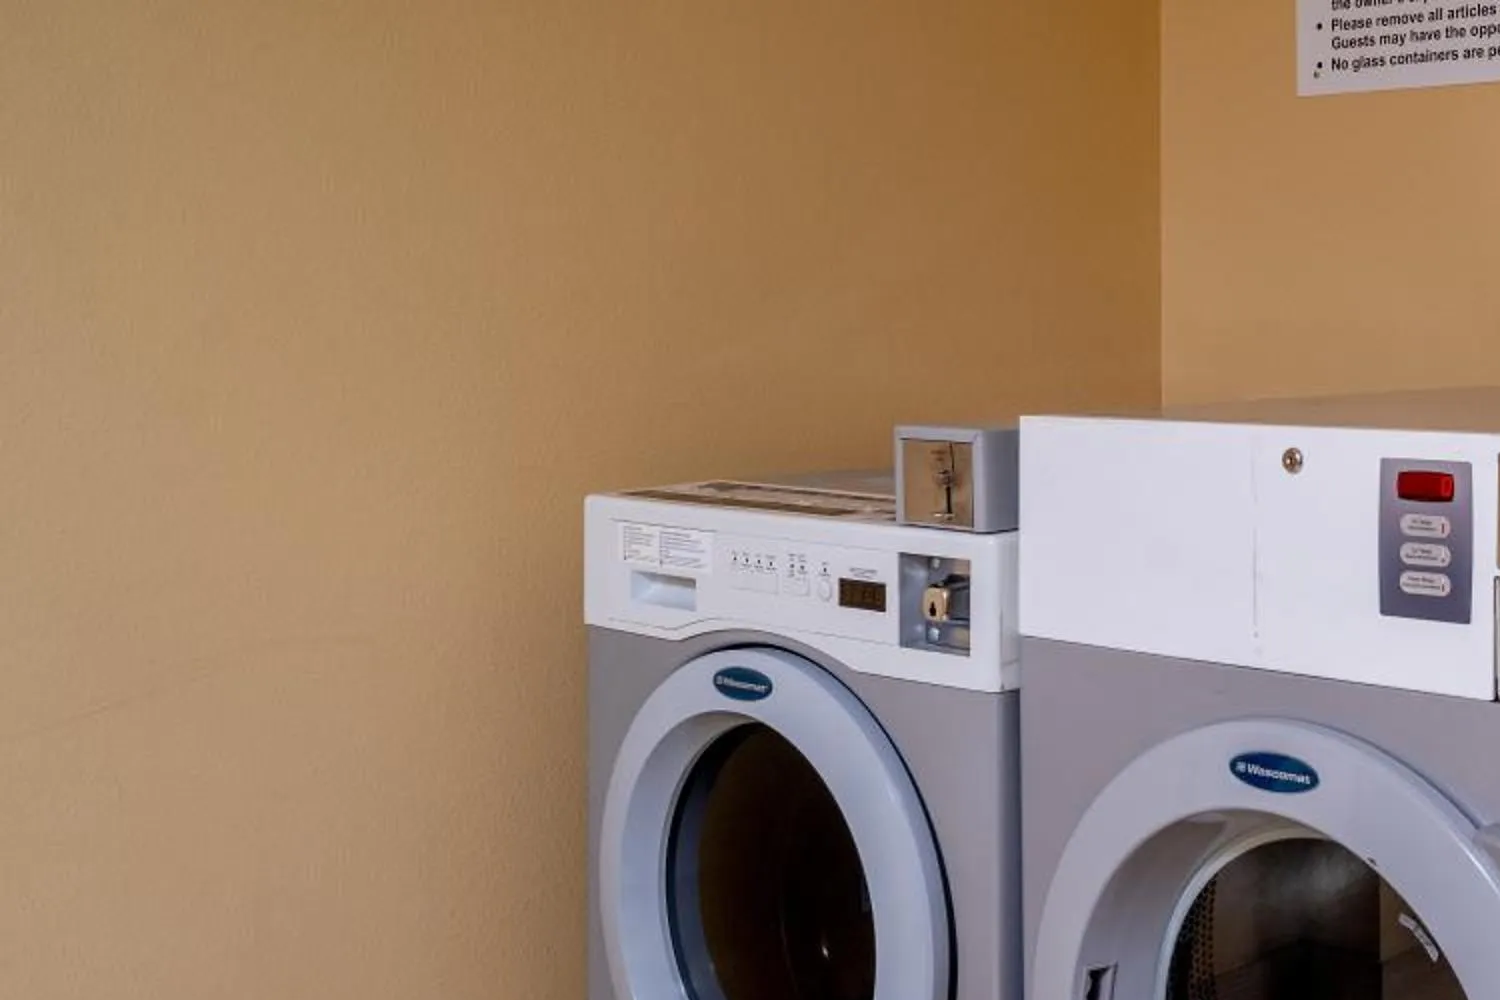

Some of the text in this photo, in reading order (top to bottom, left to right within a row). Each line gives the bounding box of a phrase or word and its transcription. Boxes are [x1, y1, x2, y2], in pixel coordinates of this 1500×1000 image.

[1331, 17, 1373, 31] Please
[1376, 12, 1424, 27] remove
[1428, 7, 1443, 21] all
[1447, 3, 1497, 20] articles
[1331, 35, 1376, 50] Guests
[1379, 33, 1407, 47] may
[1409, 29, 1441, 42] have
[1445, 26, 1467, 39] the
[1331, 57, 1349, 71] No
[1351, 55, 1386, 72] glass
[1389, 48, 1459, 66] containers
[1462, 47, 1485, 60] are
[1247, 762, 1311, 785] Wascomat
